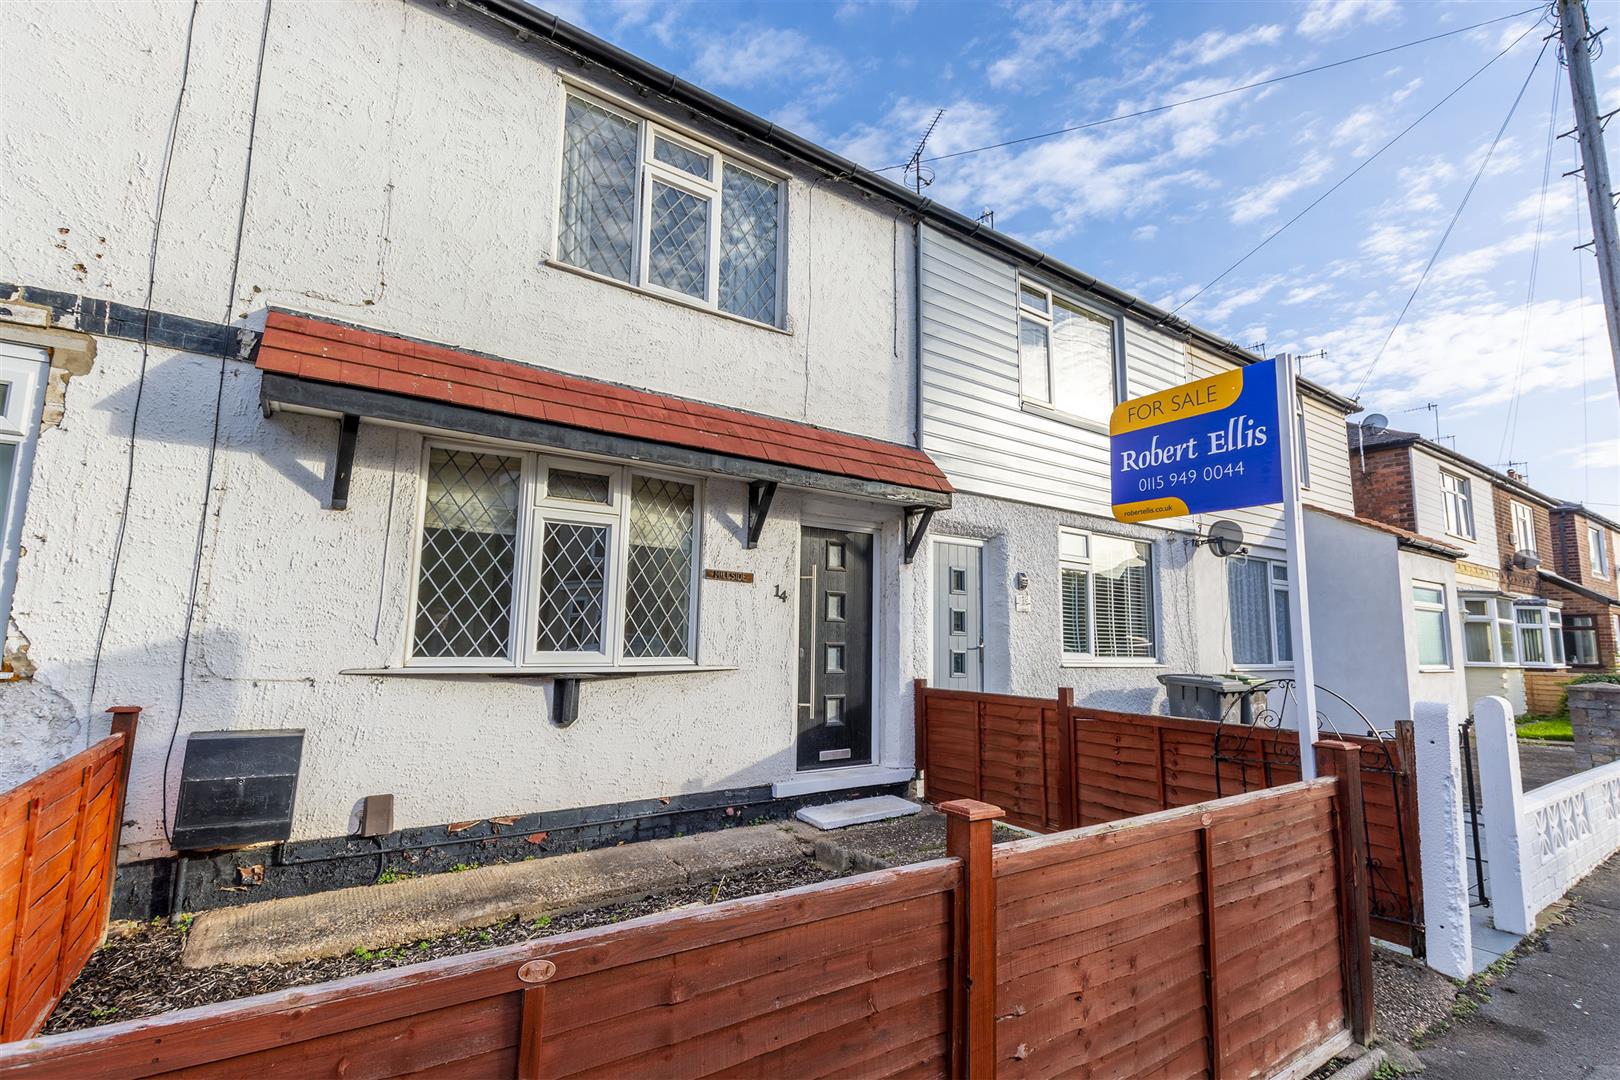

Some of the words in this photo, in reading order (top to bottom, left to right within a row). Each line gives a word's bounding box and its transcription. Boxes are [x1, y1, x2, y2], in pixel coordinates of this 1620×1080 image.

[1128, 400, 1164, 423] FOR
[1171, 385, 1217, 412] SALE
[1120, 434, 1198, 472] Robert
[1207, 414, 1268, 455] Ellis
[1138, 475, 1164, 492] 0115
[1169, 469, 1197, 487] 949
[1203, 461, 1245, 481] 0044
[1123, 505, 1173, 517] robertellis.co.uk
[773, 584, 788, 603] 14
